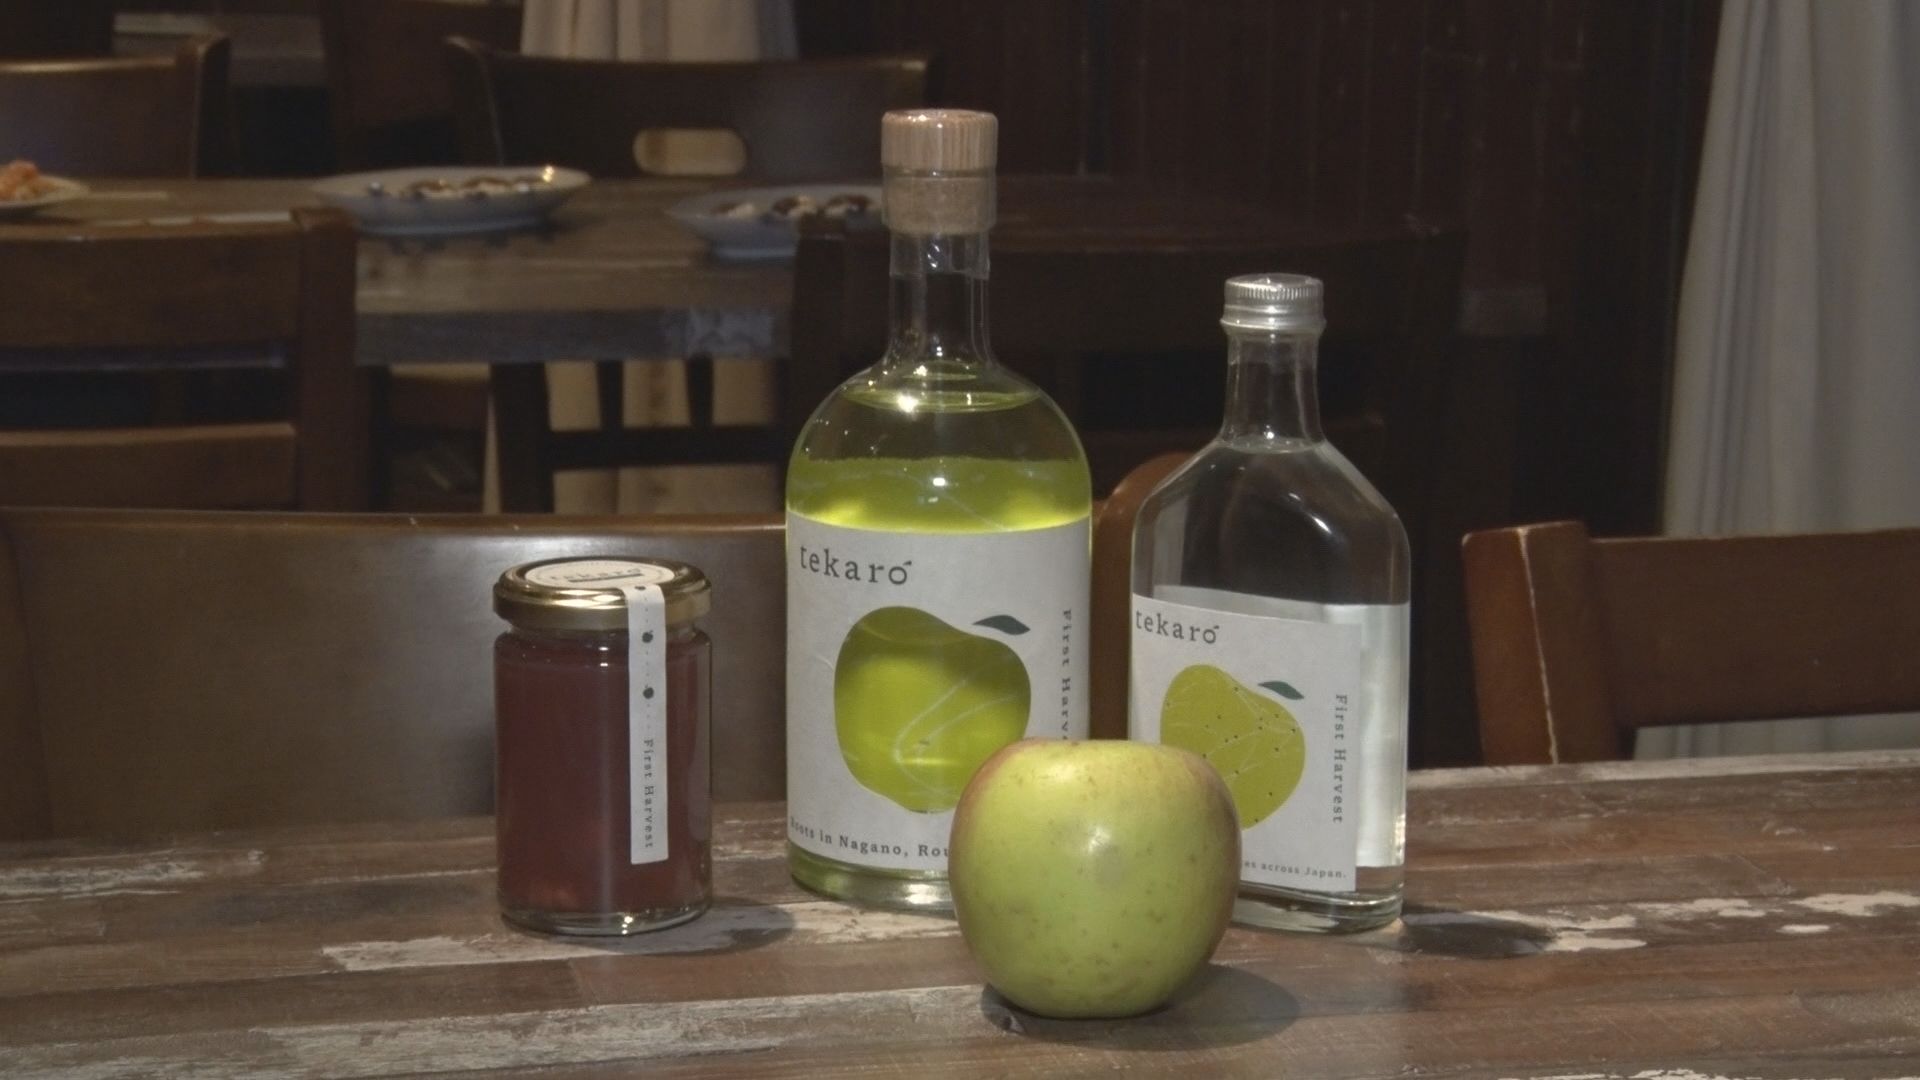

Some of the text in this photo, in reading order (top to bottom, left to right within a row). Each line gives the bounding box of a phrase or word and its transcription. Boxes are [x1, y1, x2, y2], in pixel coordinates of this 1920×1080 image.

[1062, 609, 1072, 666] First
[1333, 694, 1347, 822] First Harvest
[644, 739, 654, 848] First Harvest
[820, 829, 832, 844] in
[839, 835, 909, 857] Nagano,
[1261, 862, 1300, 874] across
[1304, 867, 1347, 879] Japan.
